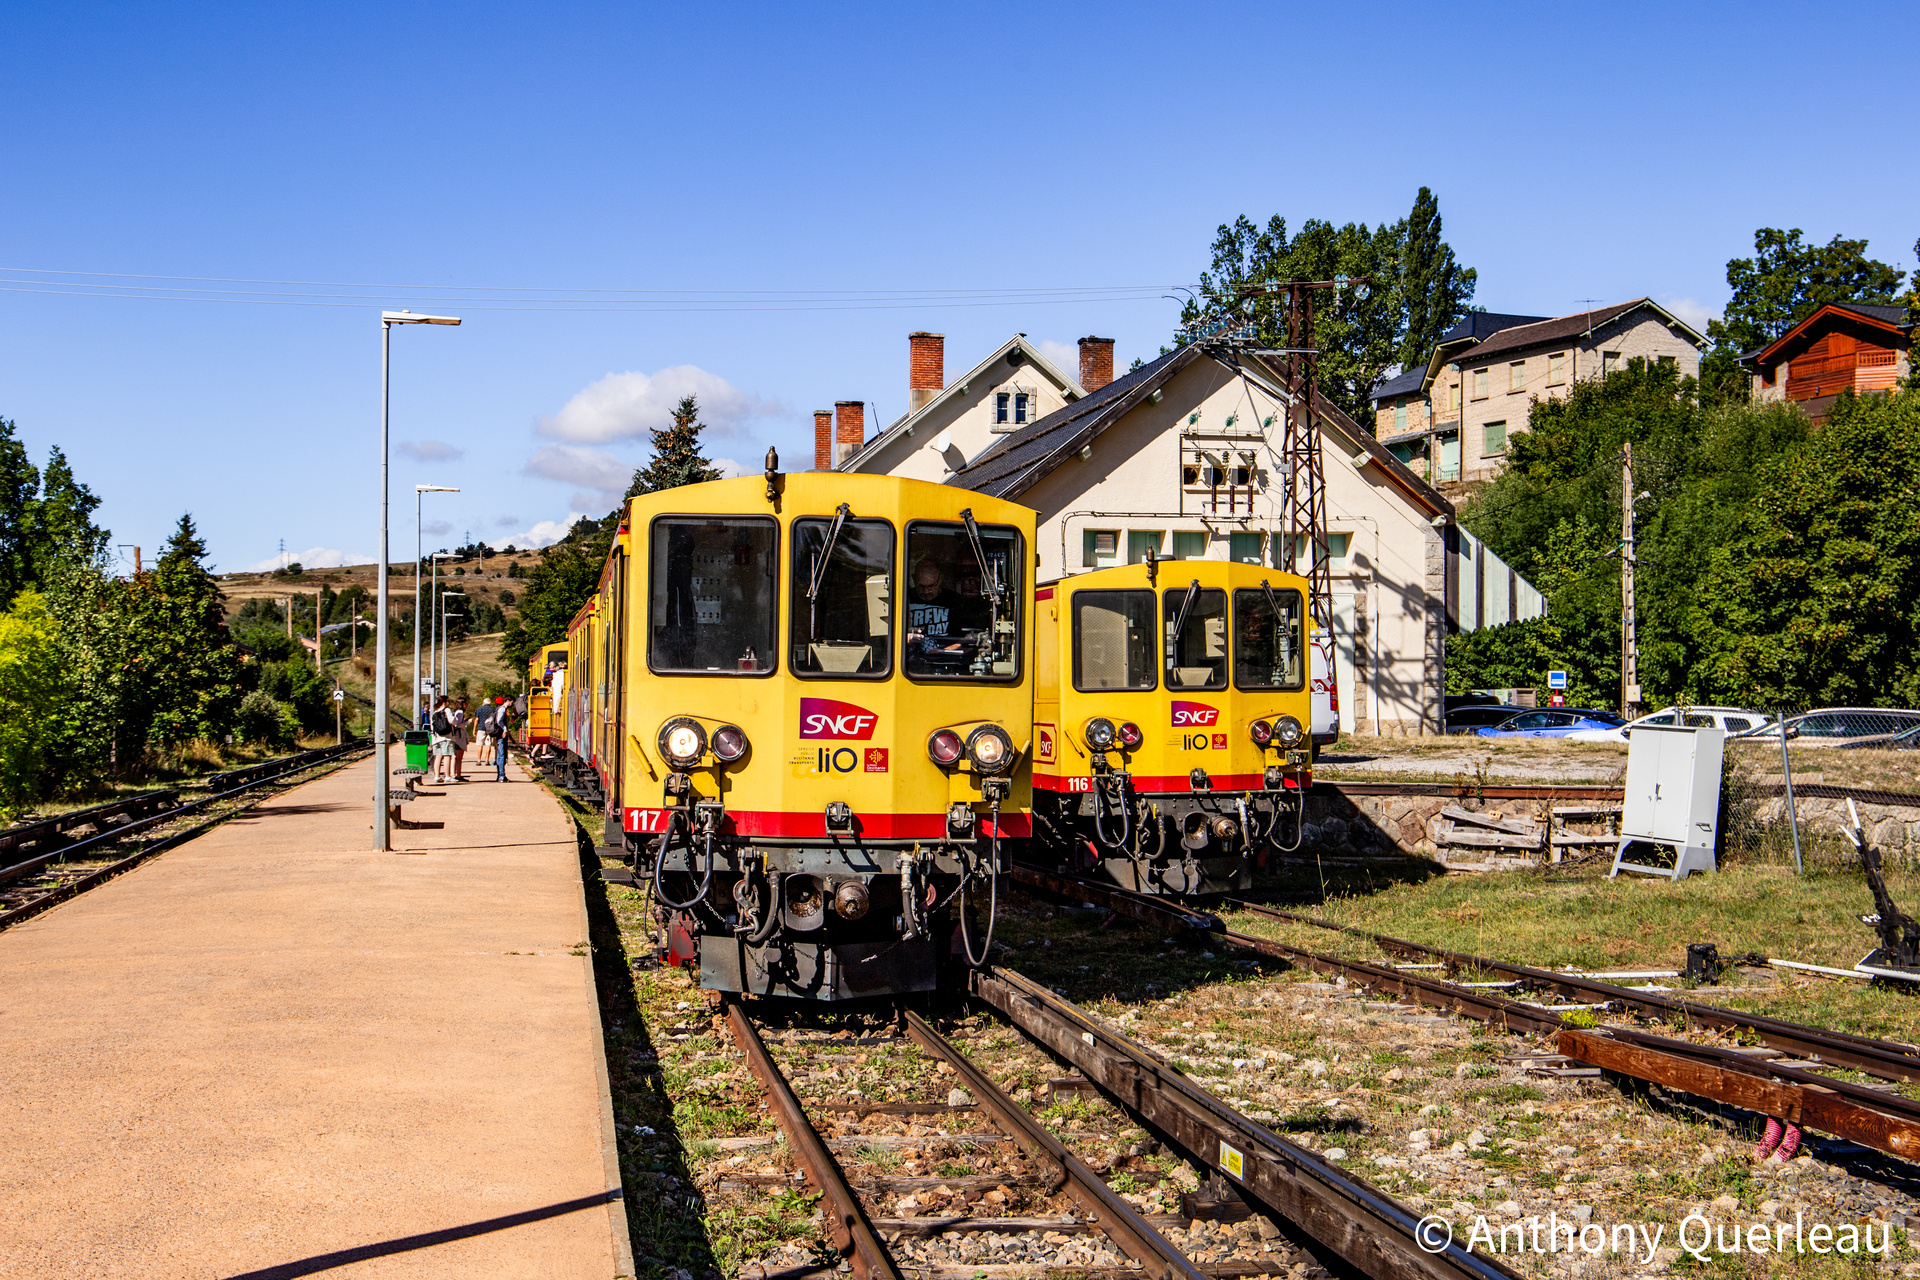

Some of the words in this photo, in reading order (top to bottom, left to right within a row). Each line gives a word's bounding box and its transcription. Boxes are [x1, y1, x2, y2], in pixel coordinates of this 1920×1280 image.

[927, 622, 949, 635] DAY
[1173, 710, 1218, 724] SNCF
[803, 714, 875, 735] SNCF
[1041, 740, 1052, 754] SNCF
[1068, 777, 1089, 792] 116
[630, 809, 662, 831] 117
